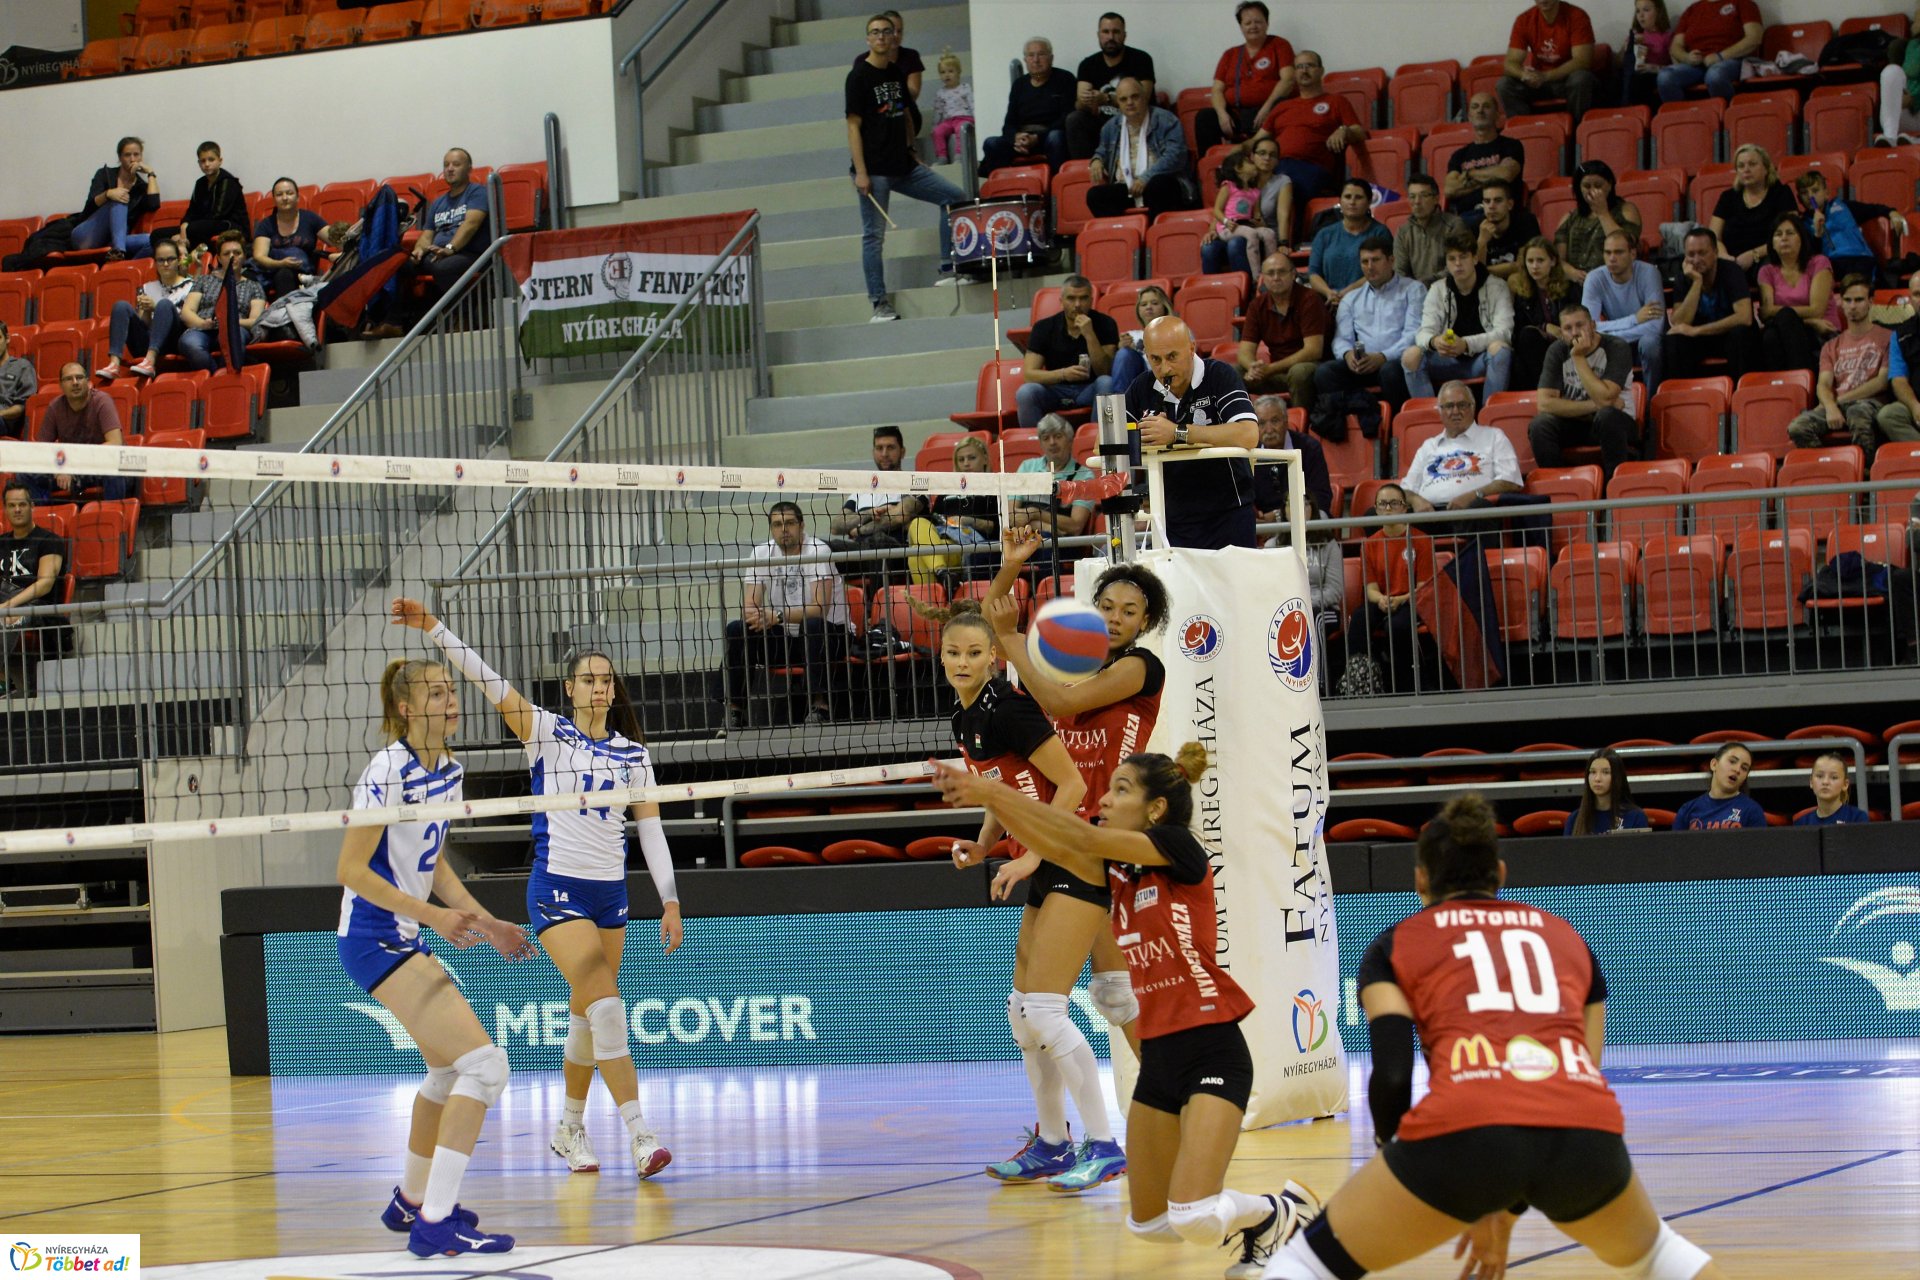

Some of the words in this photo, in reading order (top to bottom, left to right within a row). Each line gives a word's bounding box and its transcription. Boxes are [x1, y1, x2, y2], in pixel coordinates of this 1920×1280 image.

[638, 270, 746, 297] FANAICS
[1179, 616, 1202, 641] FATUM
[1270, 600, 1302, 640] FATUM
[1280, 718, 1317, 952] FATUM
[553, 889, 569, 903] 14
[1433, 909, 1544, 928] VICTORIA
[1452, 929, 1560, 1014] 10
[495, 994, 817, 1047] MECOVER
[1283, 1055, 1337, 1079] NYÍREGYHÁZA
[1200, 1076, 1224, 1085] JAKO
